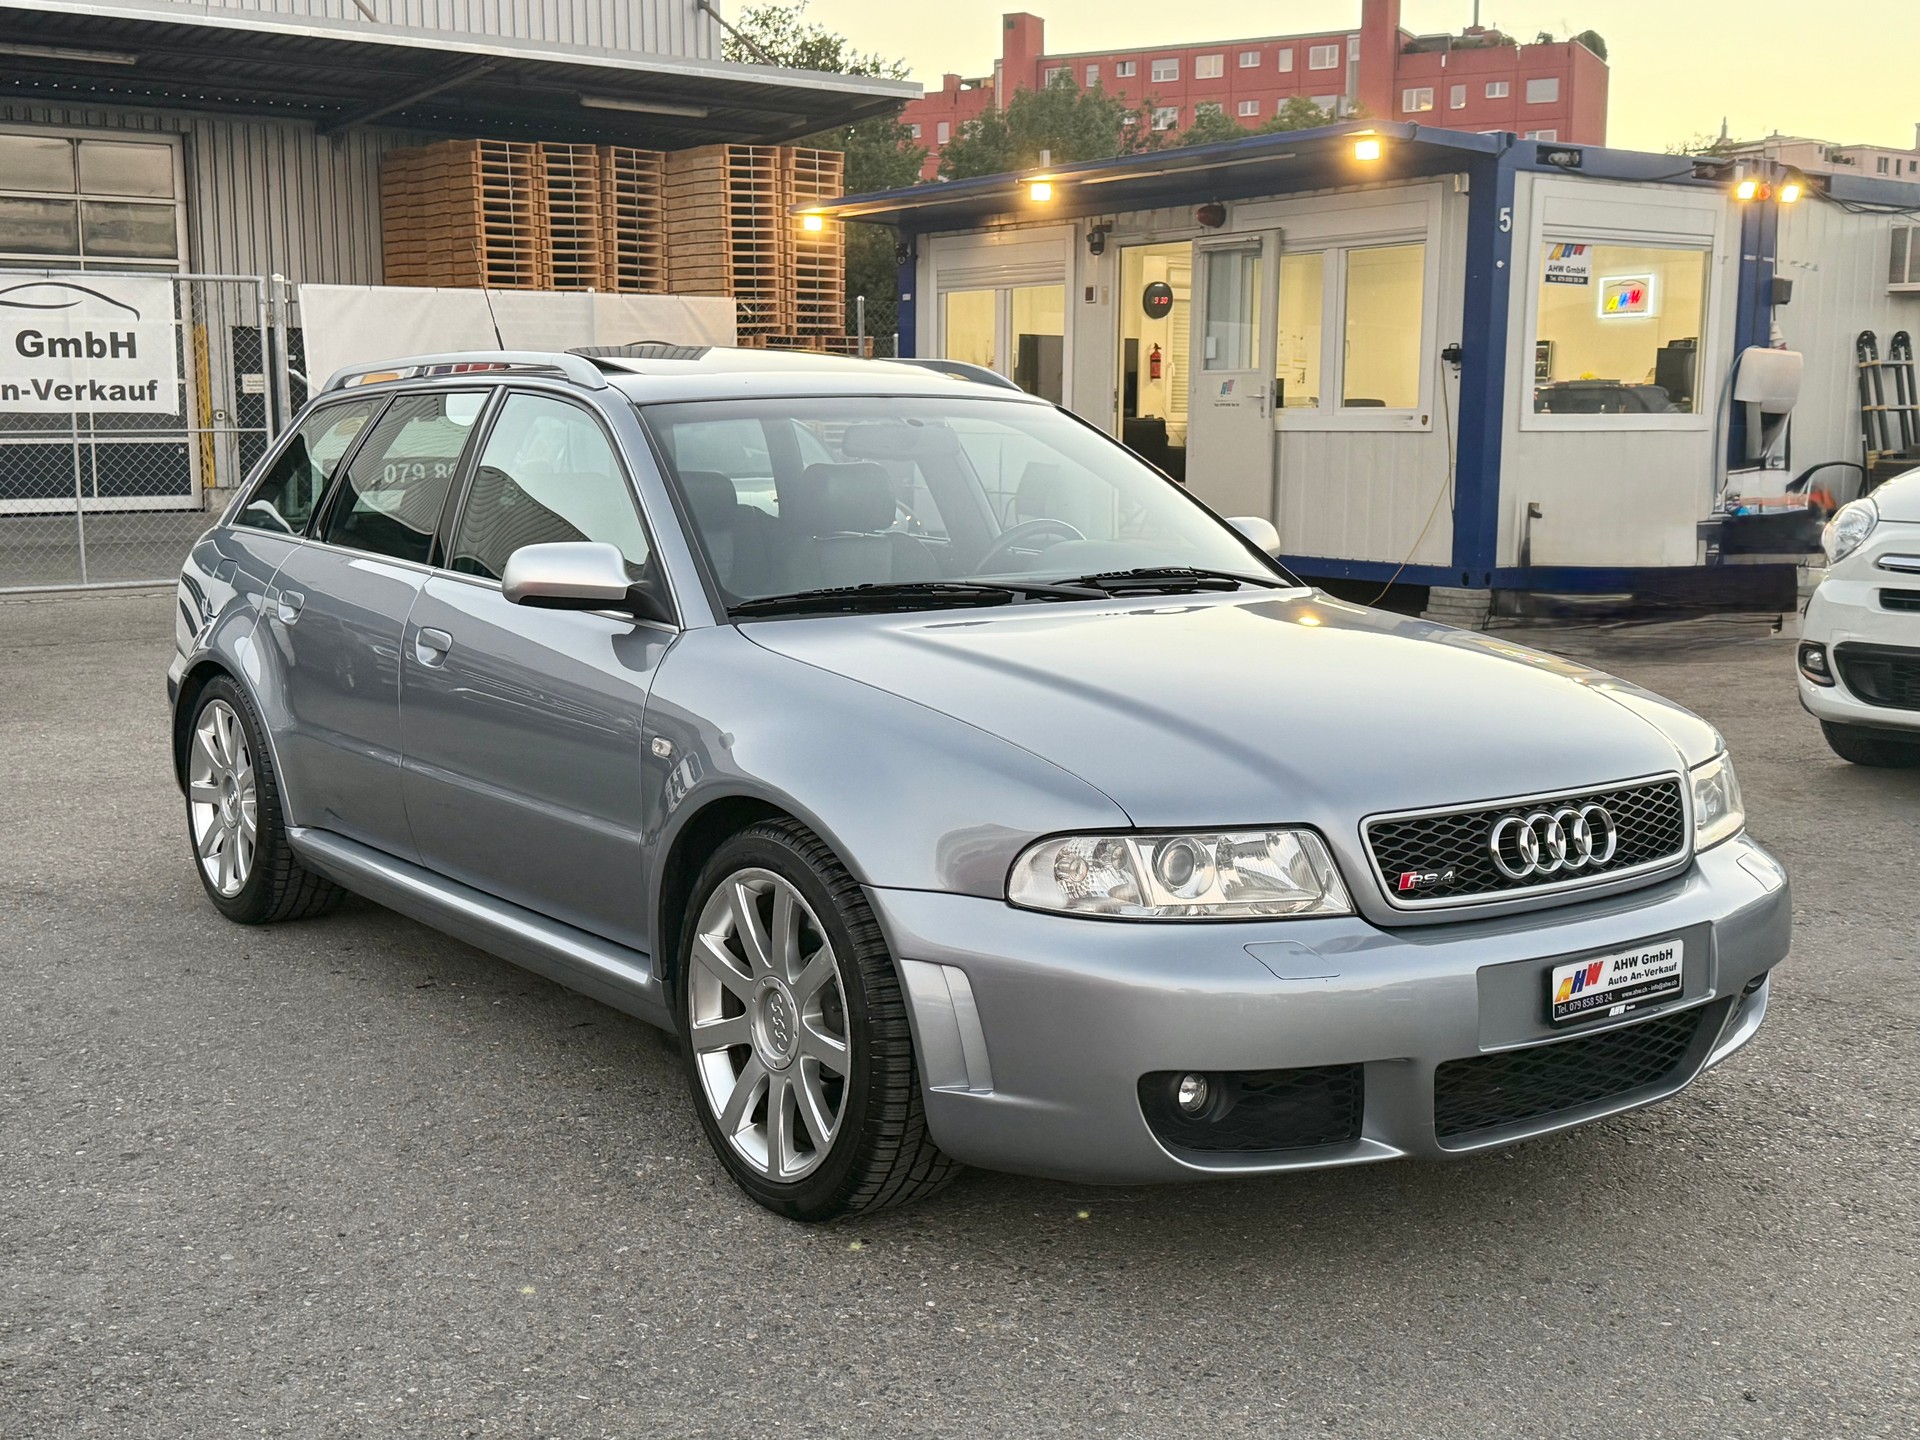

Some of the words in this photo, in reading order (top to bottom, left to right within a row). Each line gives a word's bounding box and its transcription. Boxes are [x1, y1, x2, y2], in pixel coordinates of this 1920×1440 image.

[1499, 207, 1511, 232] 5
[1566, 266, 1586, 274] GmbH
[15, 329, 137, 358] GmbH
[1, 378, 158, 401] n-Verkauf
[384, 463, 425, 483] 079
[1613, 956, 1638, 972] AHW
[1642, 948, 1672, 965] GmbH
[1555, 961, 1603, 1002] AHW
[1608, 974, 1628, 986] Auto
[1631, 962, 1677, 981] An-Verkauf
[1557, 1003, 1568, 1014] Tel.
[1570, 1000, 1581, 1011] 079
[1583, 997, 1594, 1008] 858
[1595, 994, 1603, 1005] 58
[1604, 992, 1612, 1003] 24
